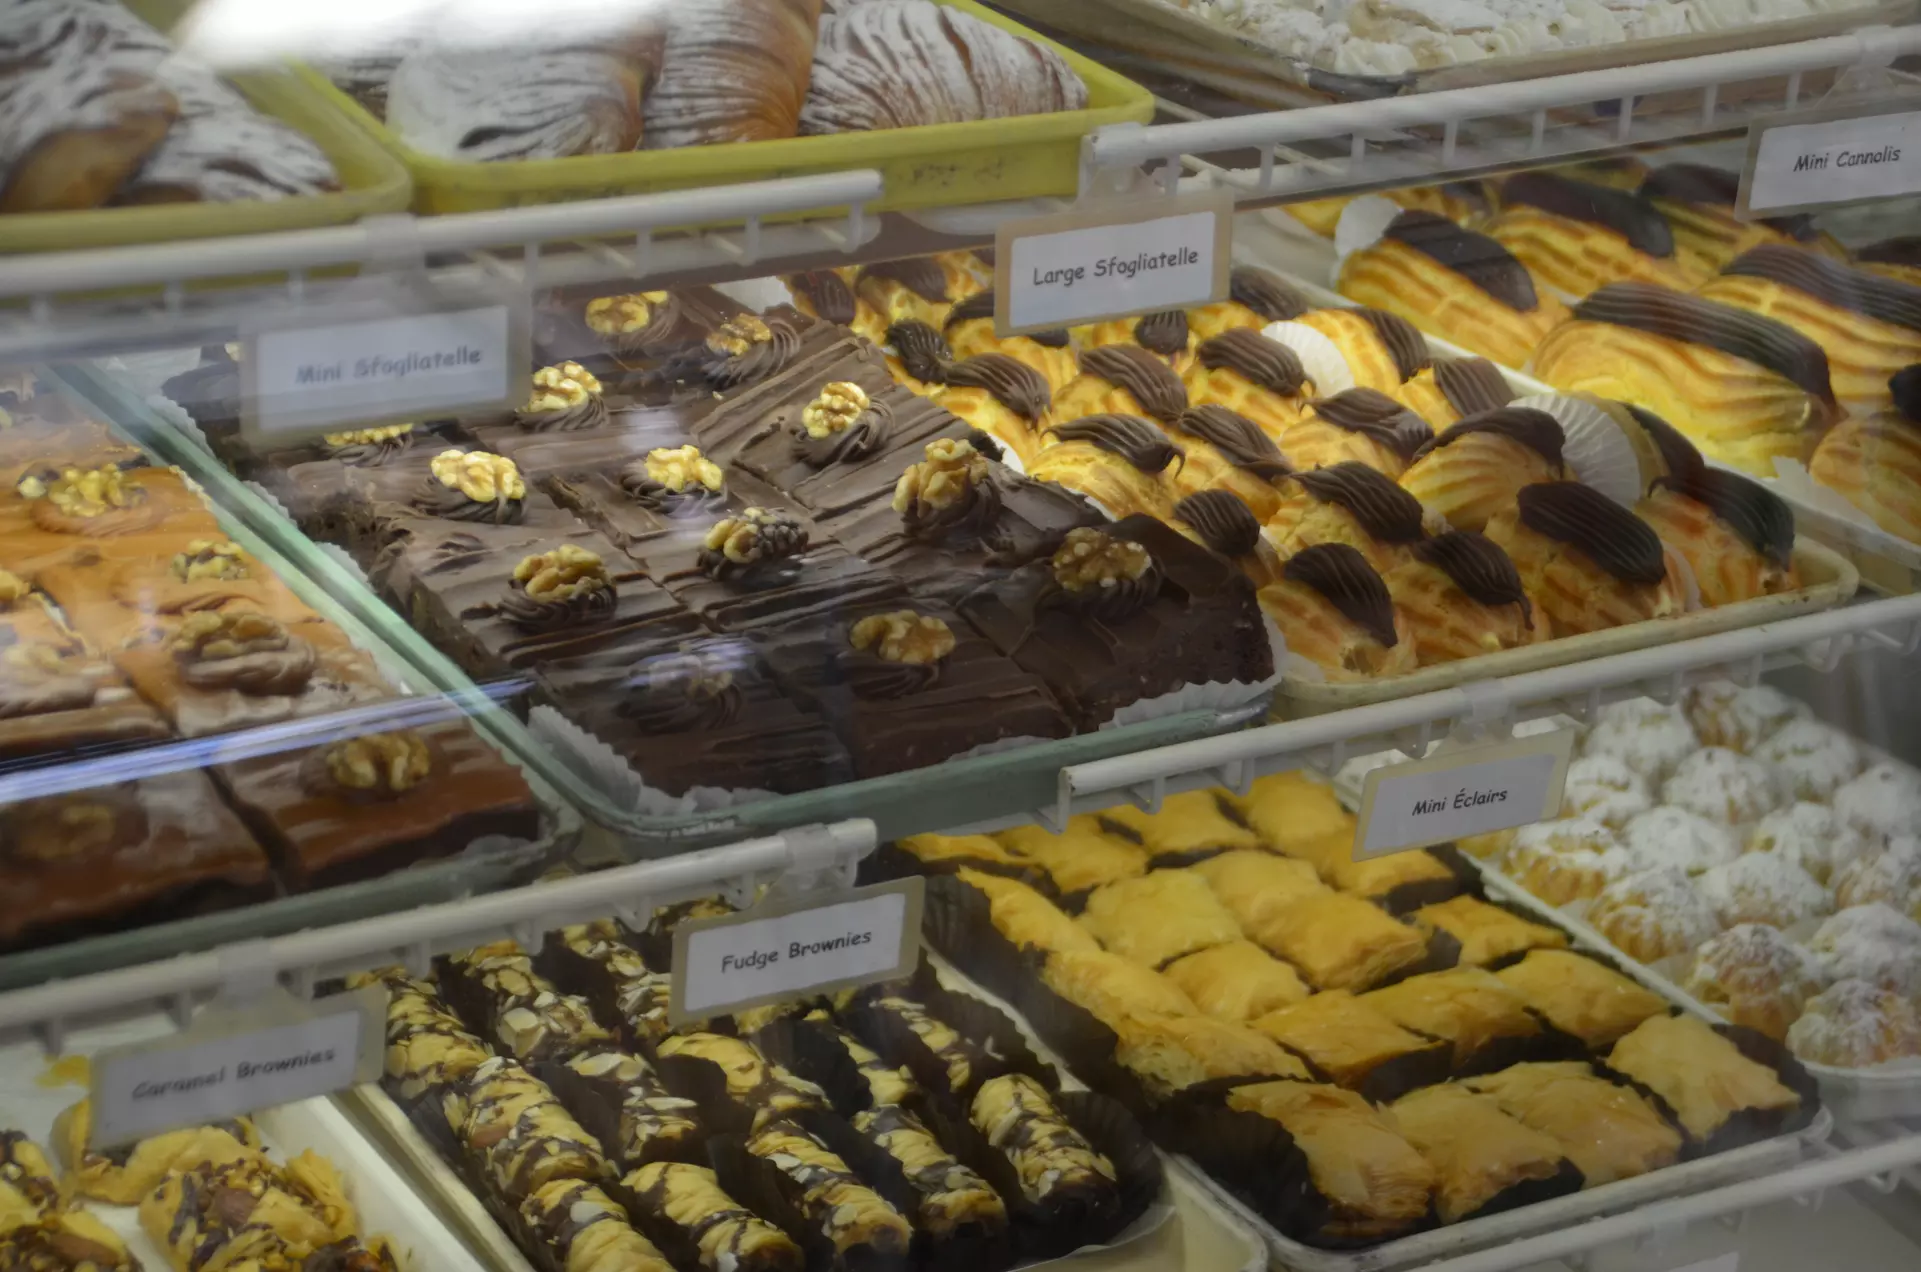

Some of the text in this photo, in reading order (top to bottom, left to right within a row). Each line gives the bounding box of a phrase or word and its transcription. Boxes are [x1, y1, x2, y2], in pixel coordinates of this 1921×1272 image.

[1793, 145, 1901, 172] Mini Cannolis
[1033, 246, 1199, 287] Large Sfogliatelle
[295, 345, 481, 384] Mini Sfogliatelle
[1412, 788, 1508, 816] Mini Éclairs
[721, 931, 872, 973] Fudge Brownies
[131, 1048, 336, 1100] Caramel Brownies
